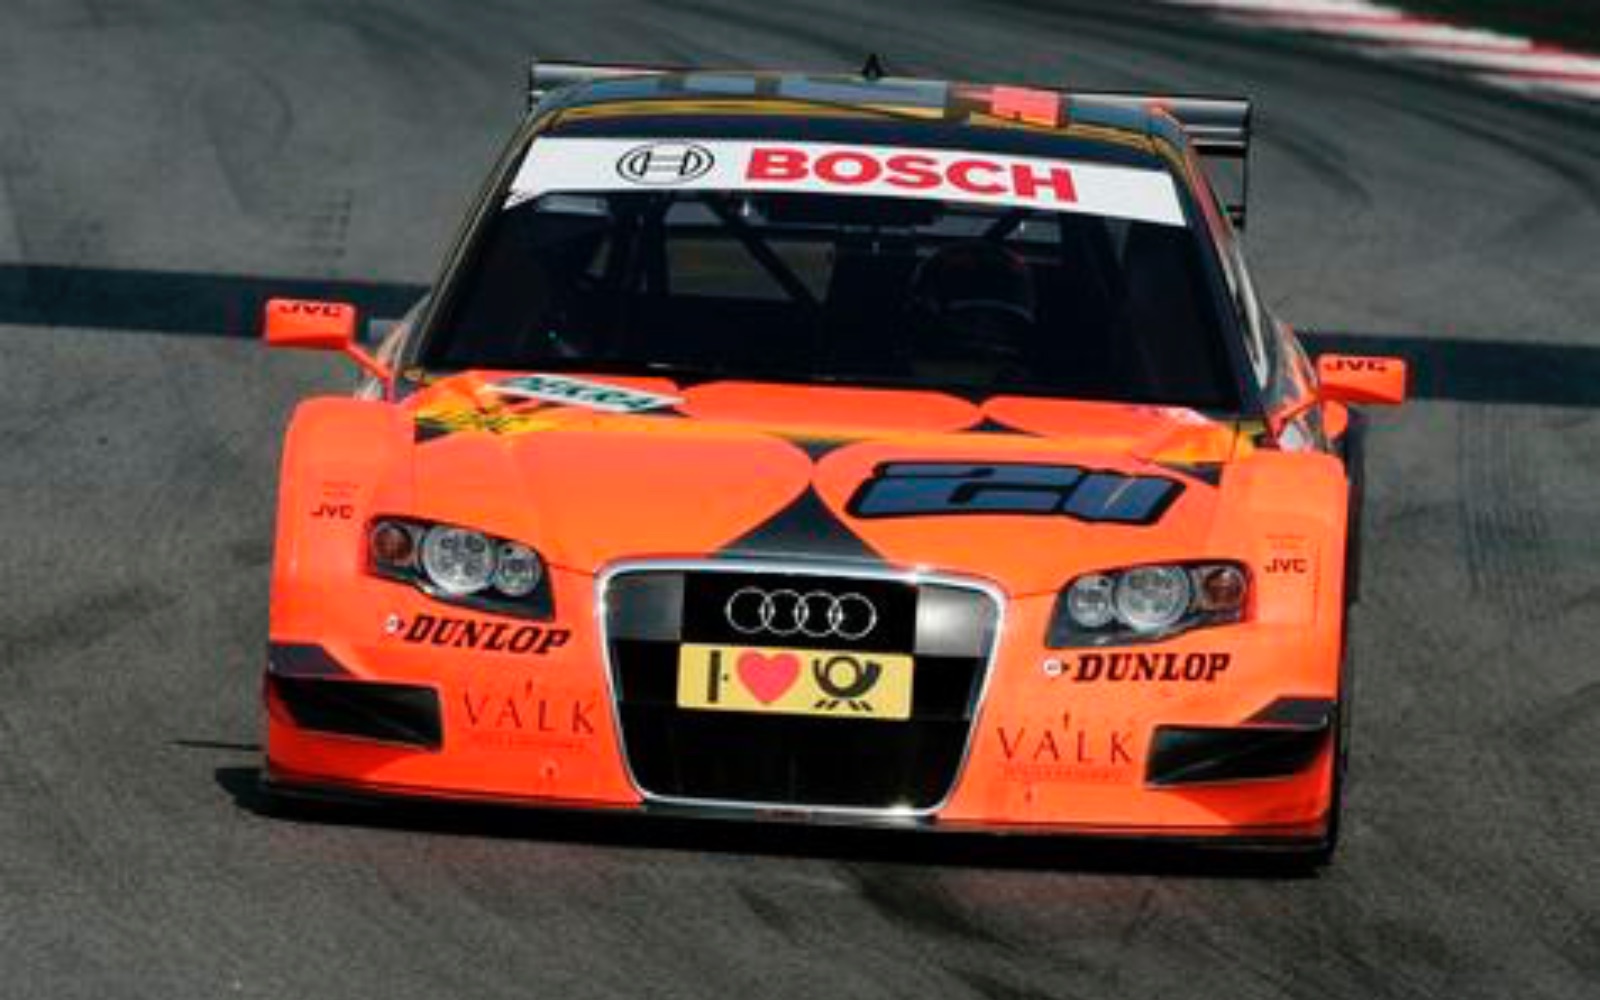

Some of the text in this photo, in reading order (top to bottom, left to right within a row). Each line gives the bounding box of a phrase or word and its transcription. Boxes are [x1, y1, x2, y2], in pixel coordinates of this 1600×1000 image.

[745, 147, 1078, 202] BOSCH
[310, 502, 355, 520] JVC
[1263, 558, 1307, 574] JVC
[403, 614, 572, 655] DUNLOP
[1072, 652, 1231, 682] DUNLOP
[997, 726, 1133, 765] VALK
